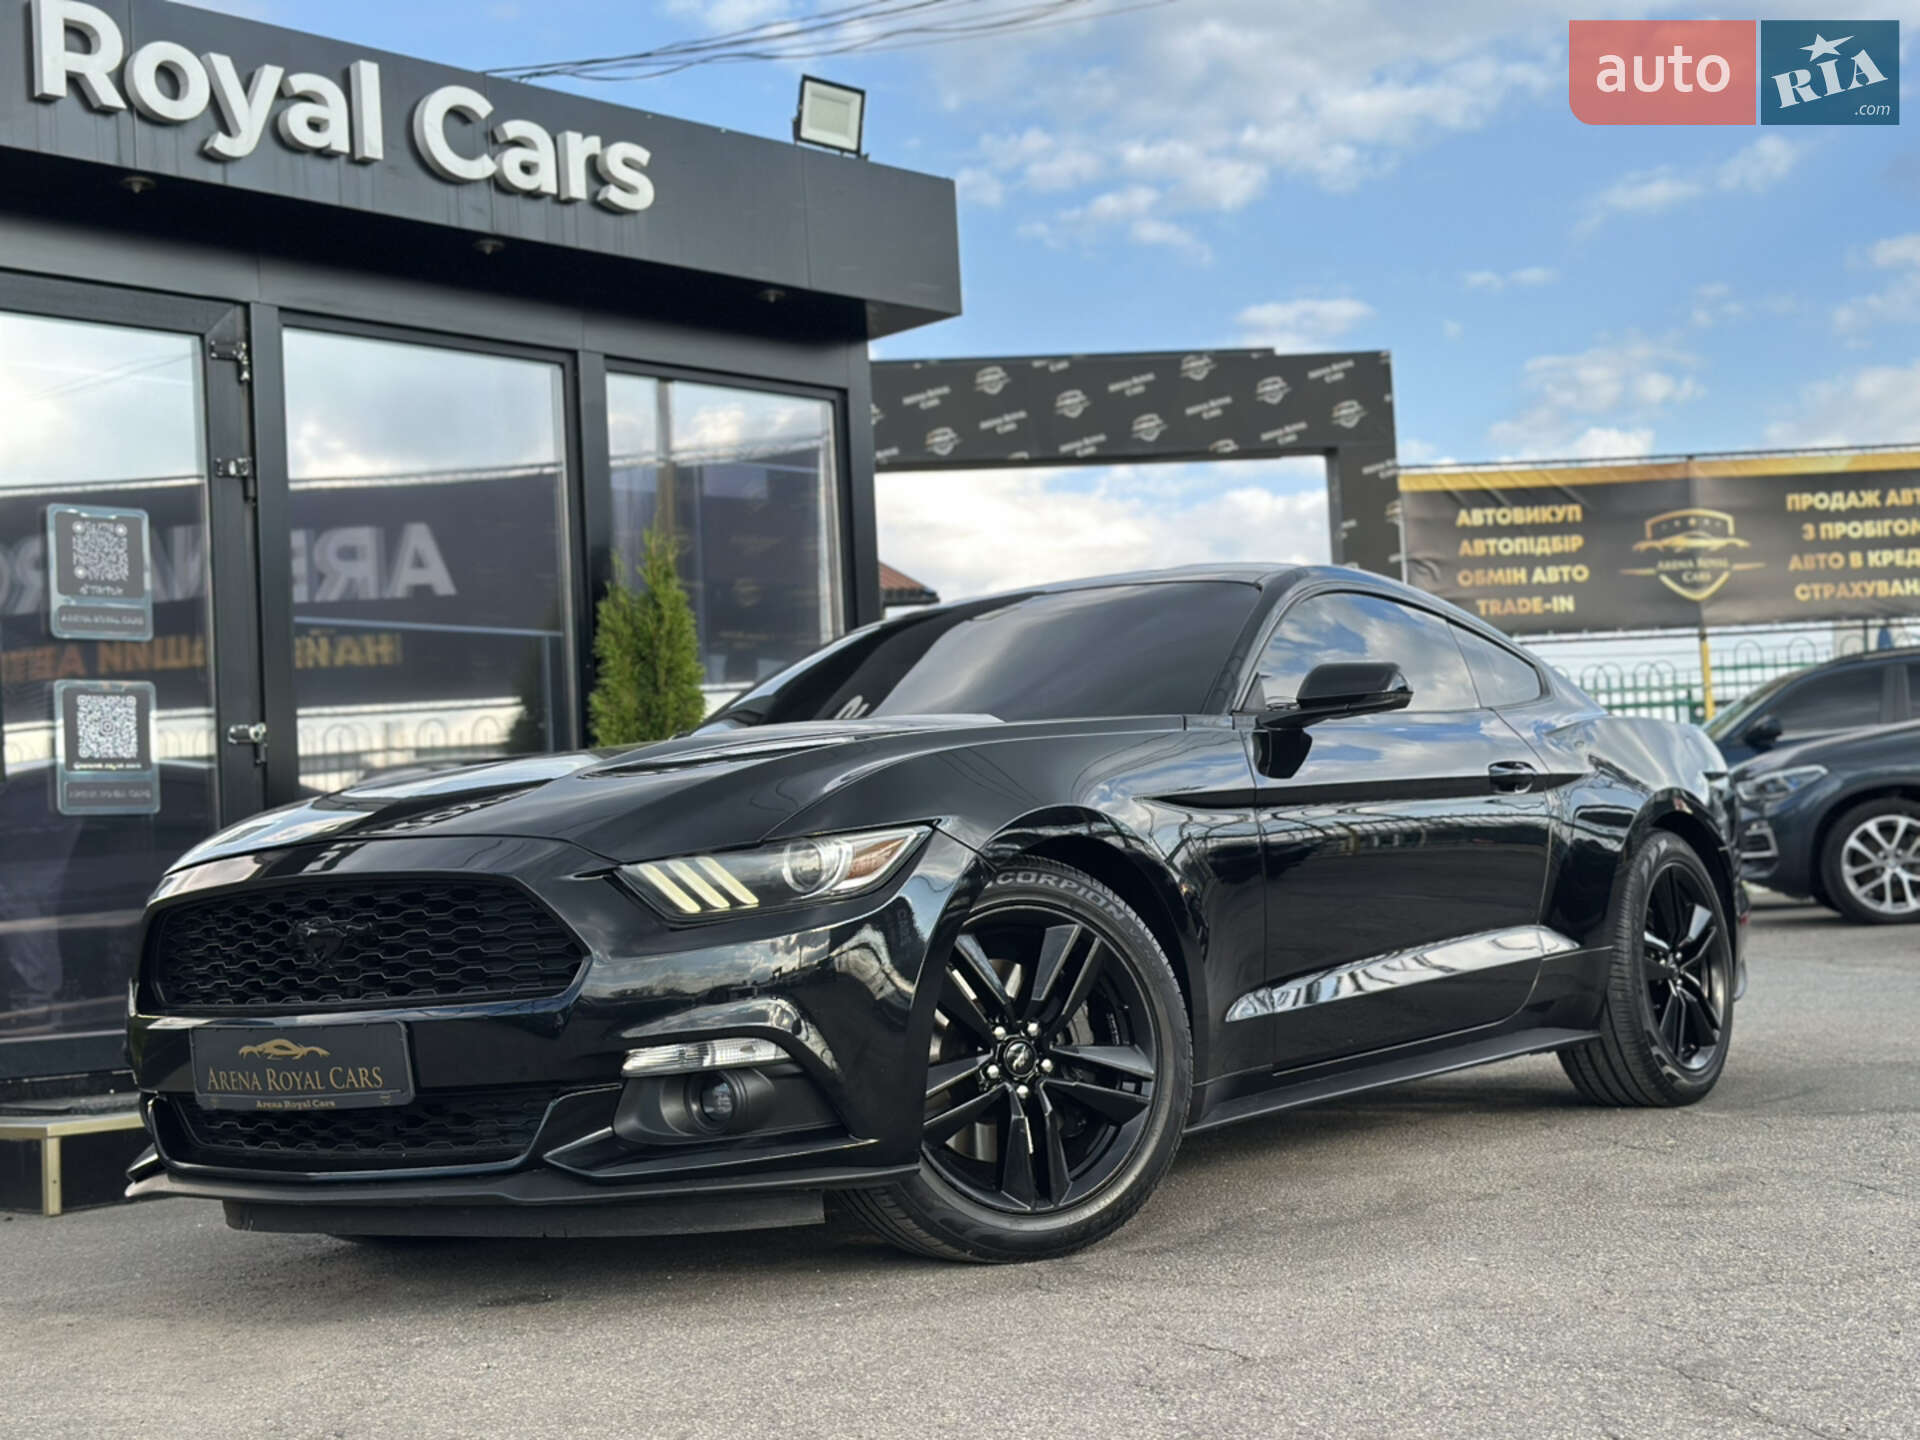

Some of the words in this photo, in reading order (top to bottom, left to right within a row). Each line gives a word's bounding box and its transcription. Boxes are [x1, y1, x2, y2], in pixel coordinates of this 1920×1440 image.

[31, 0, 384, 162] Royal
[412, 85, 655, 214] Cars
[1786, 490, 1881, 512] ПРОДАЖ
[1456, 504, 1583, 527] АВТОВИКУП
[1459, 535, 1584, 557] АВТОПІДБІР
[1789, 551, 1845, 571] АВТО
[1849, 551, 1864, 568] В
[1457, 567, 1527, 587] ОБМІН
[1532, 564, 1589, 584] АВТО
[1476, 596, 1575, 616] TRADE-IN
[984, 871, 1125, 921] CORPION
[207, 1067, 262, 1091] ARENA
[266, 1067, 325, 1092] ROYAL
[329, 1066, 384, 1090] CARS
